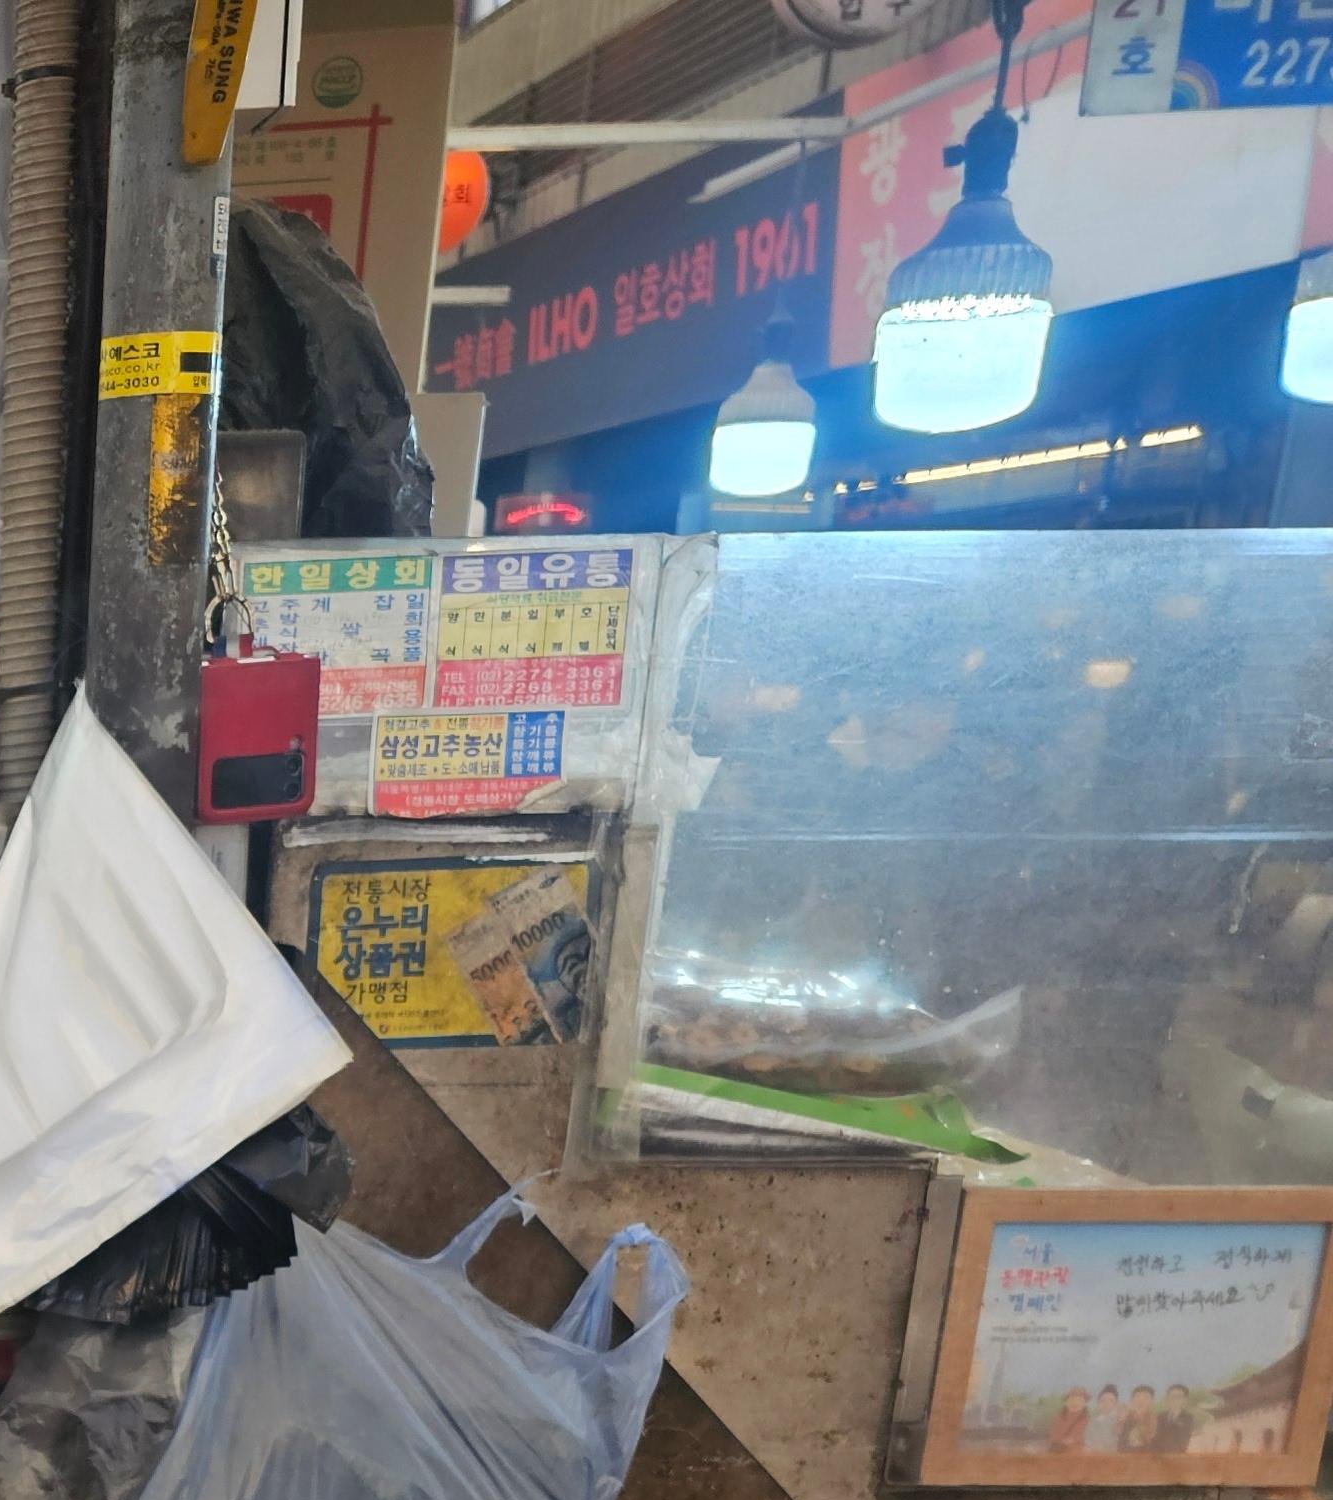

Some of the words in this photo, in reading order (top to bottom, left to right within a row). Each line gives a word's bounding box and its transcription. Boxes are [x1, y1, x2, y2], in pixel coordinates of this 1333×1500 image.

[212, 46, 235, 104] SUNG
[1112, 35, 1156, 76] 호
[1241, 37, 1333, 87] 227
[528, 285, 599, 366] ILHO
[612, 236, 717, 337] 일호상회
[734, 200, 820, 297] 1961
[102, 376, 160, 392] 44-3030
[251, 559, 425, 593] 한일상회
[452, 553, 620, 593] 동일유통
[380, 733, 503, 759] 삼성고추농산
[342, 879, 432, 904] 전통시장
[336, 903, 429, 945] 온누리
[334, 940, 426, 981] 상품권
[345, 980, 408, 1004] 가맹점
